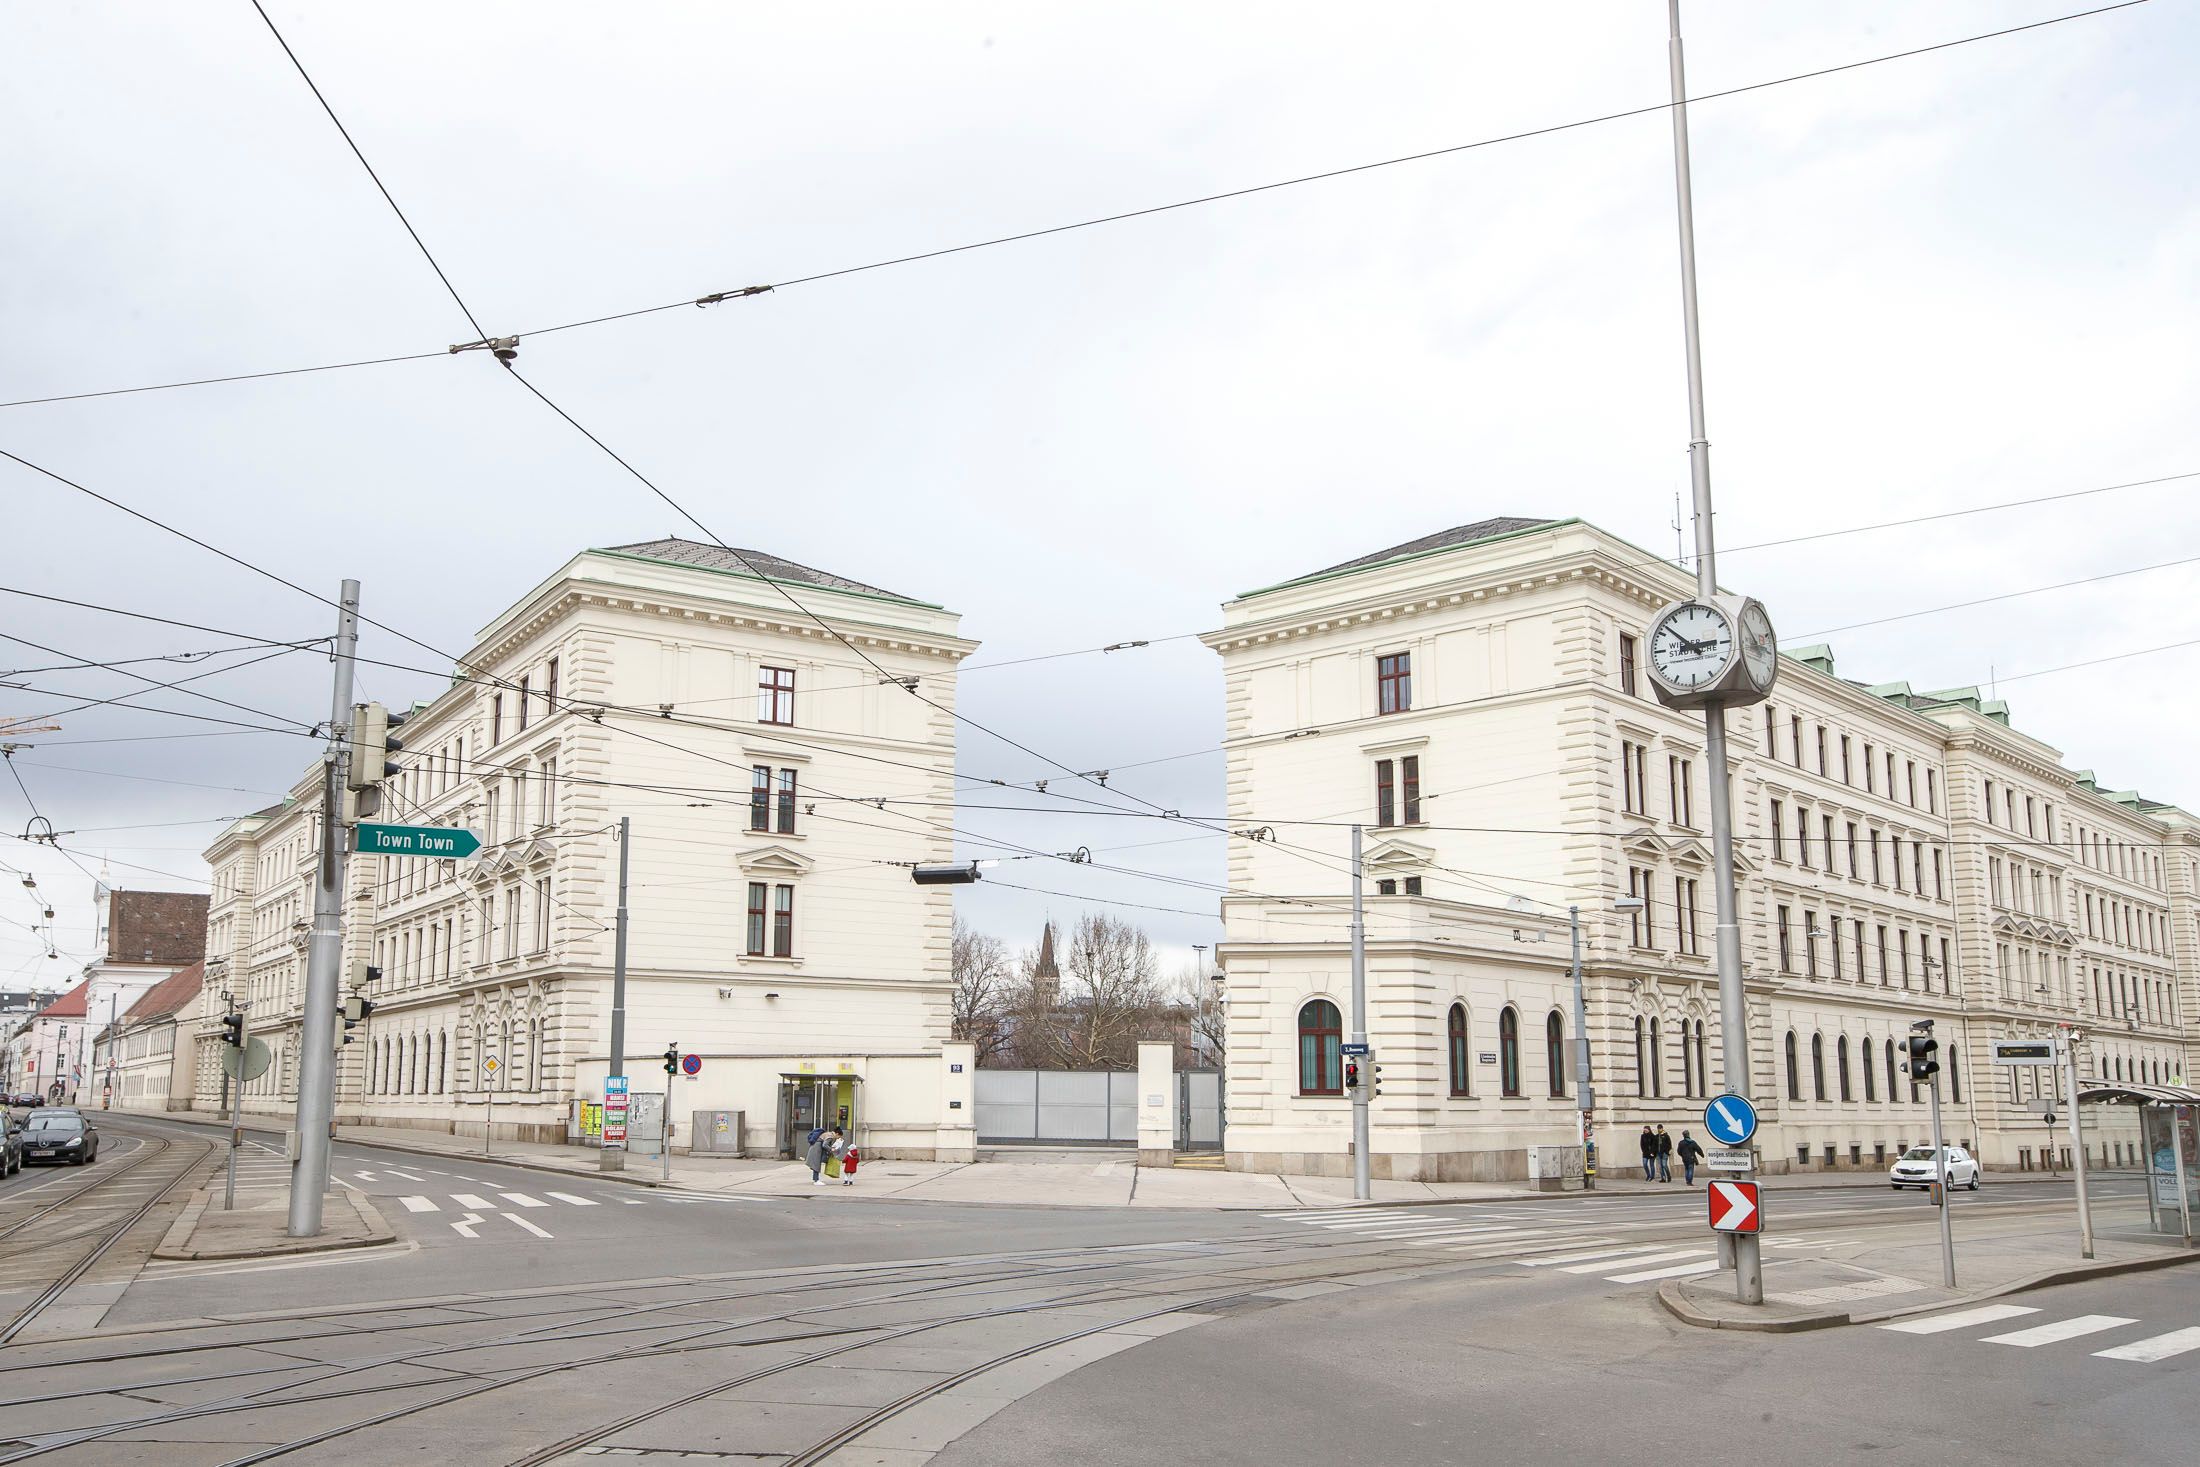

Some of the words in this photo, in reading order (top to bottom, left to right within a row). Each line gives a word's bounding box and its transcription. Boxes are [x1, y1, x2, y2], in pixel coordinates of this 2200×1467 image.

[1669, 639, 1701, 649] WIEER
[1669, 645, 1717, 658] STÄDCHE
[376, 831, 411, 848] Town
[418, 833, 453, 850] Town
[608, 1078, 622, 1088] NIK
